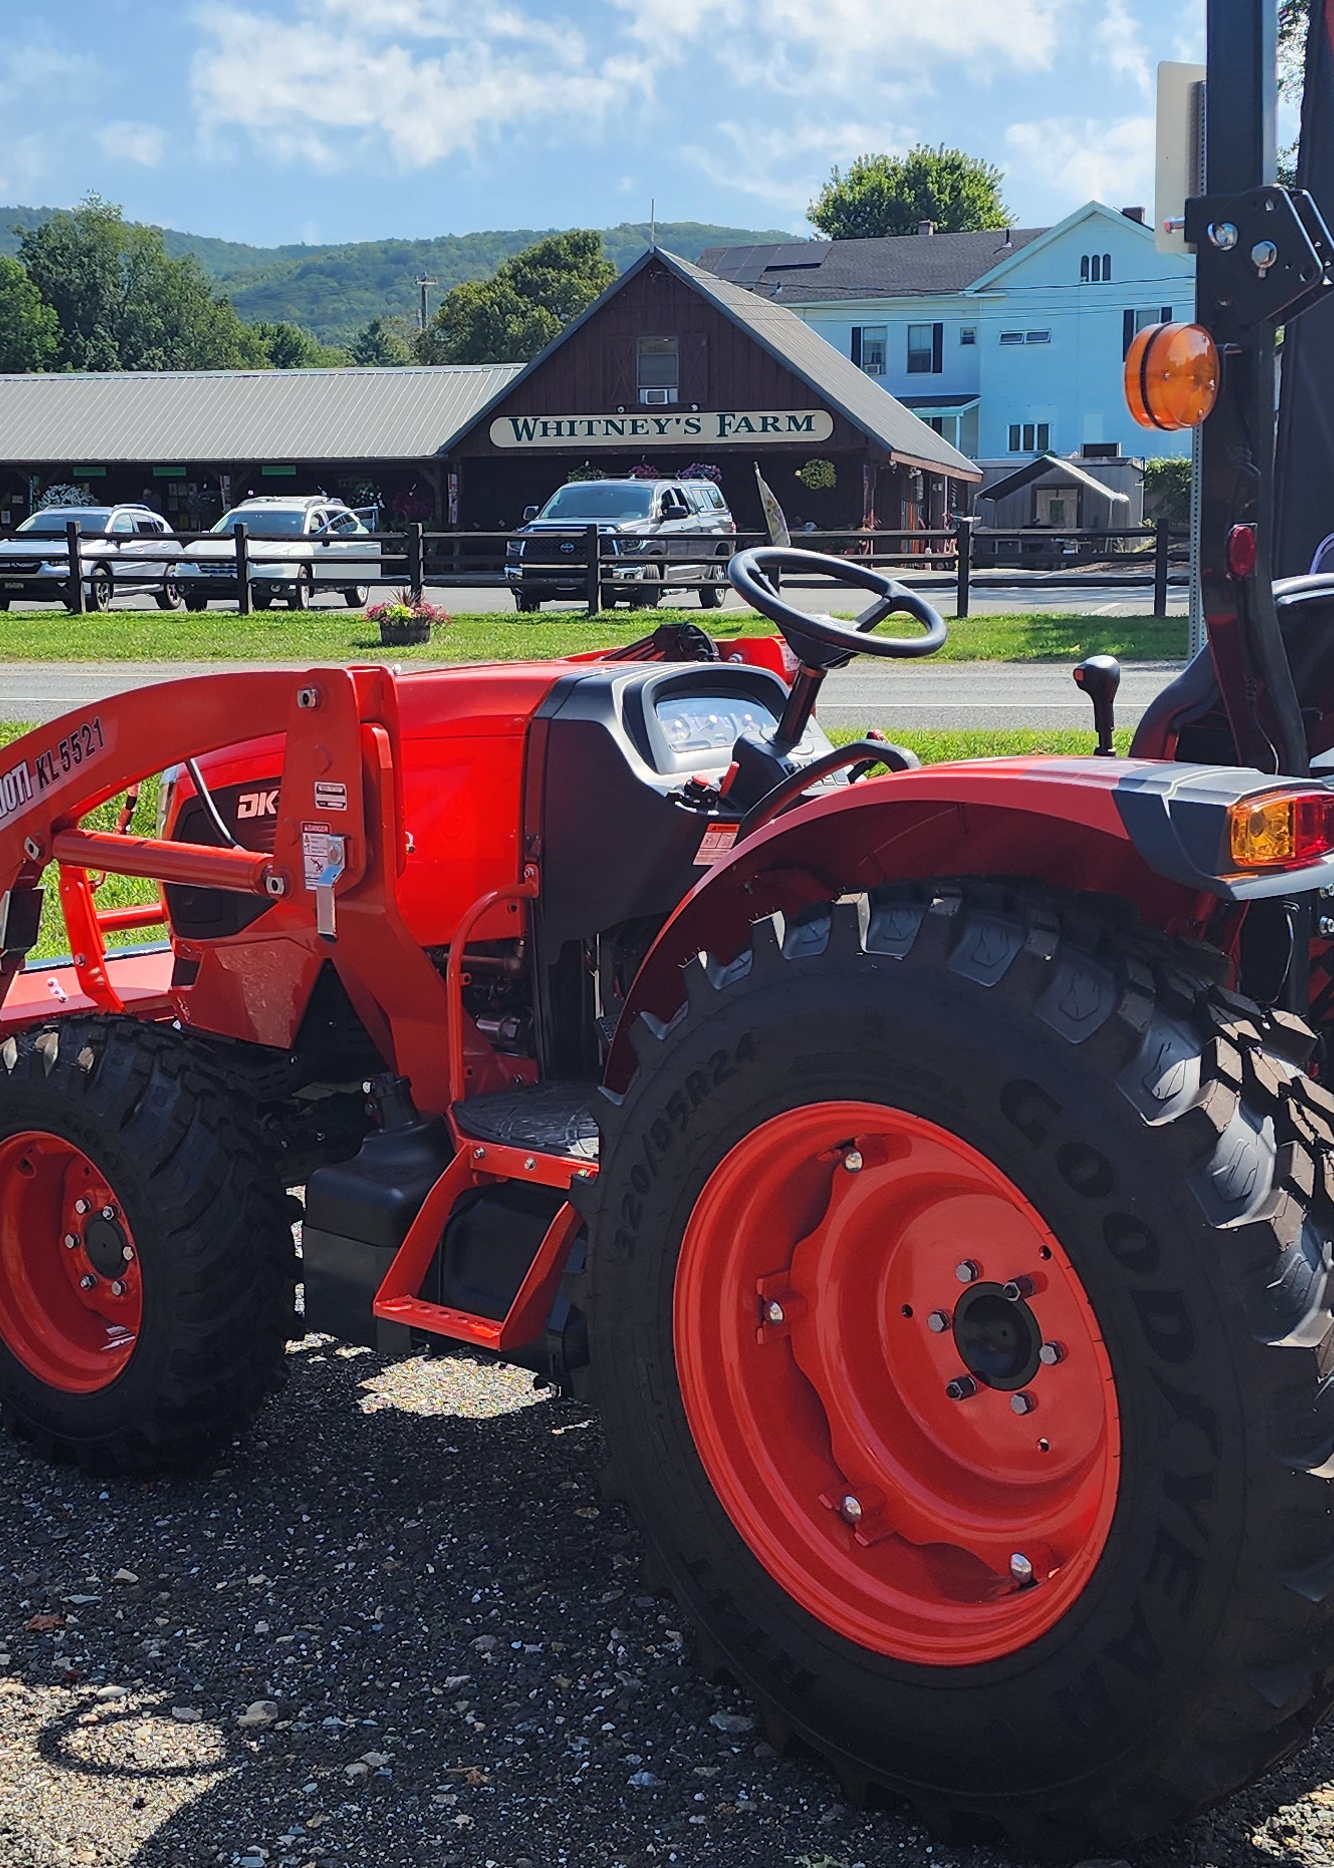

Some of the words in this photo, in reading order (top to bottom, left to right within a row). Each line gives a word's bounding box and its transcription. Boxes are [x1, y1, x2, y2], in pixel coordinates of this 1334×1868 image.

[508, 415, 702, 442] WHITNEY'S
[716, 412, 816, 438] FARM
[237, 789, 280, 819] DK
[612, 1030, 760, 1261] 320/85R24
[998, 1075, 1223, 1743] GOODYEAR
